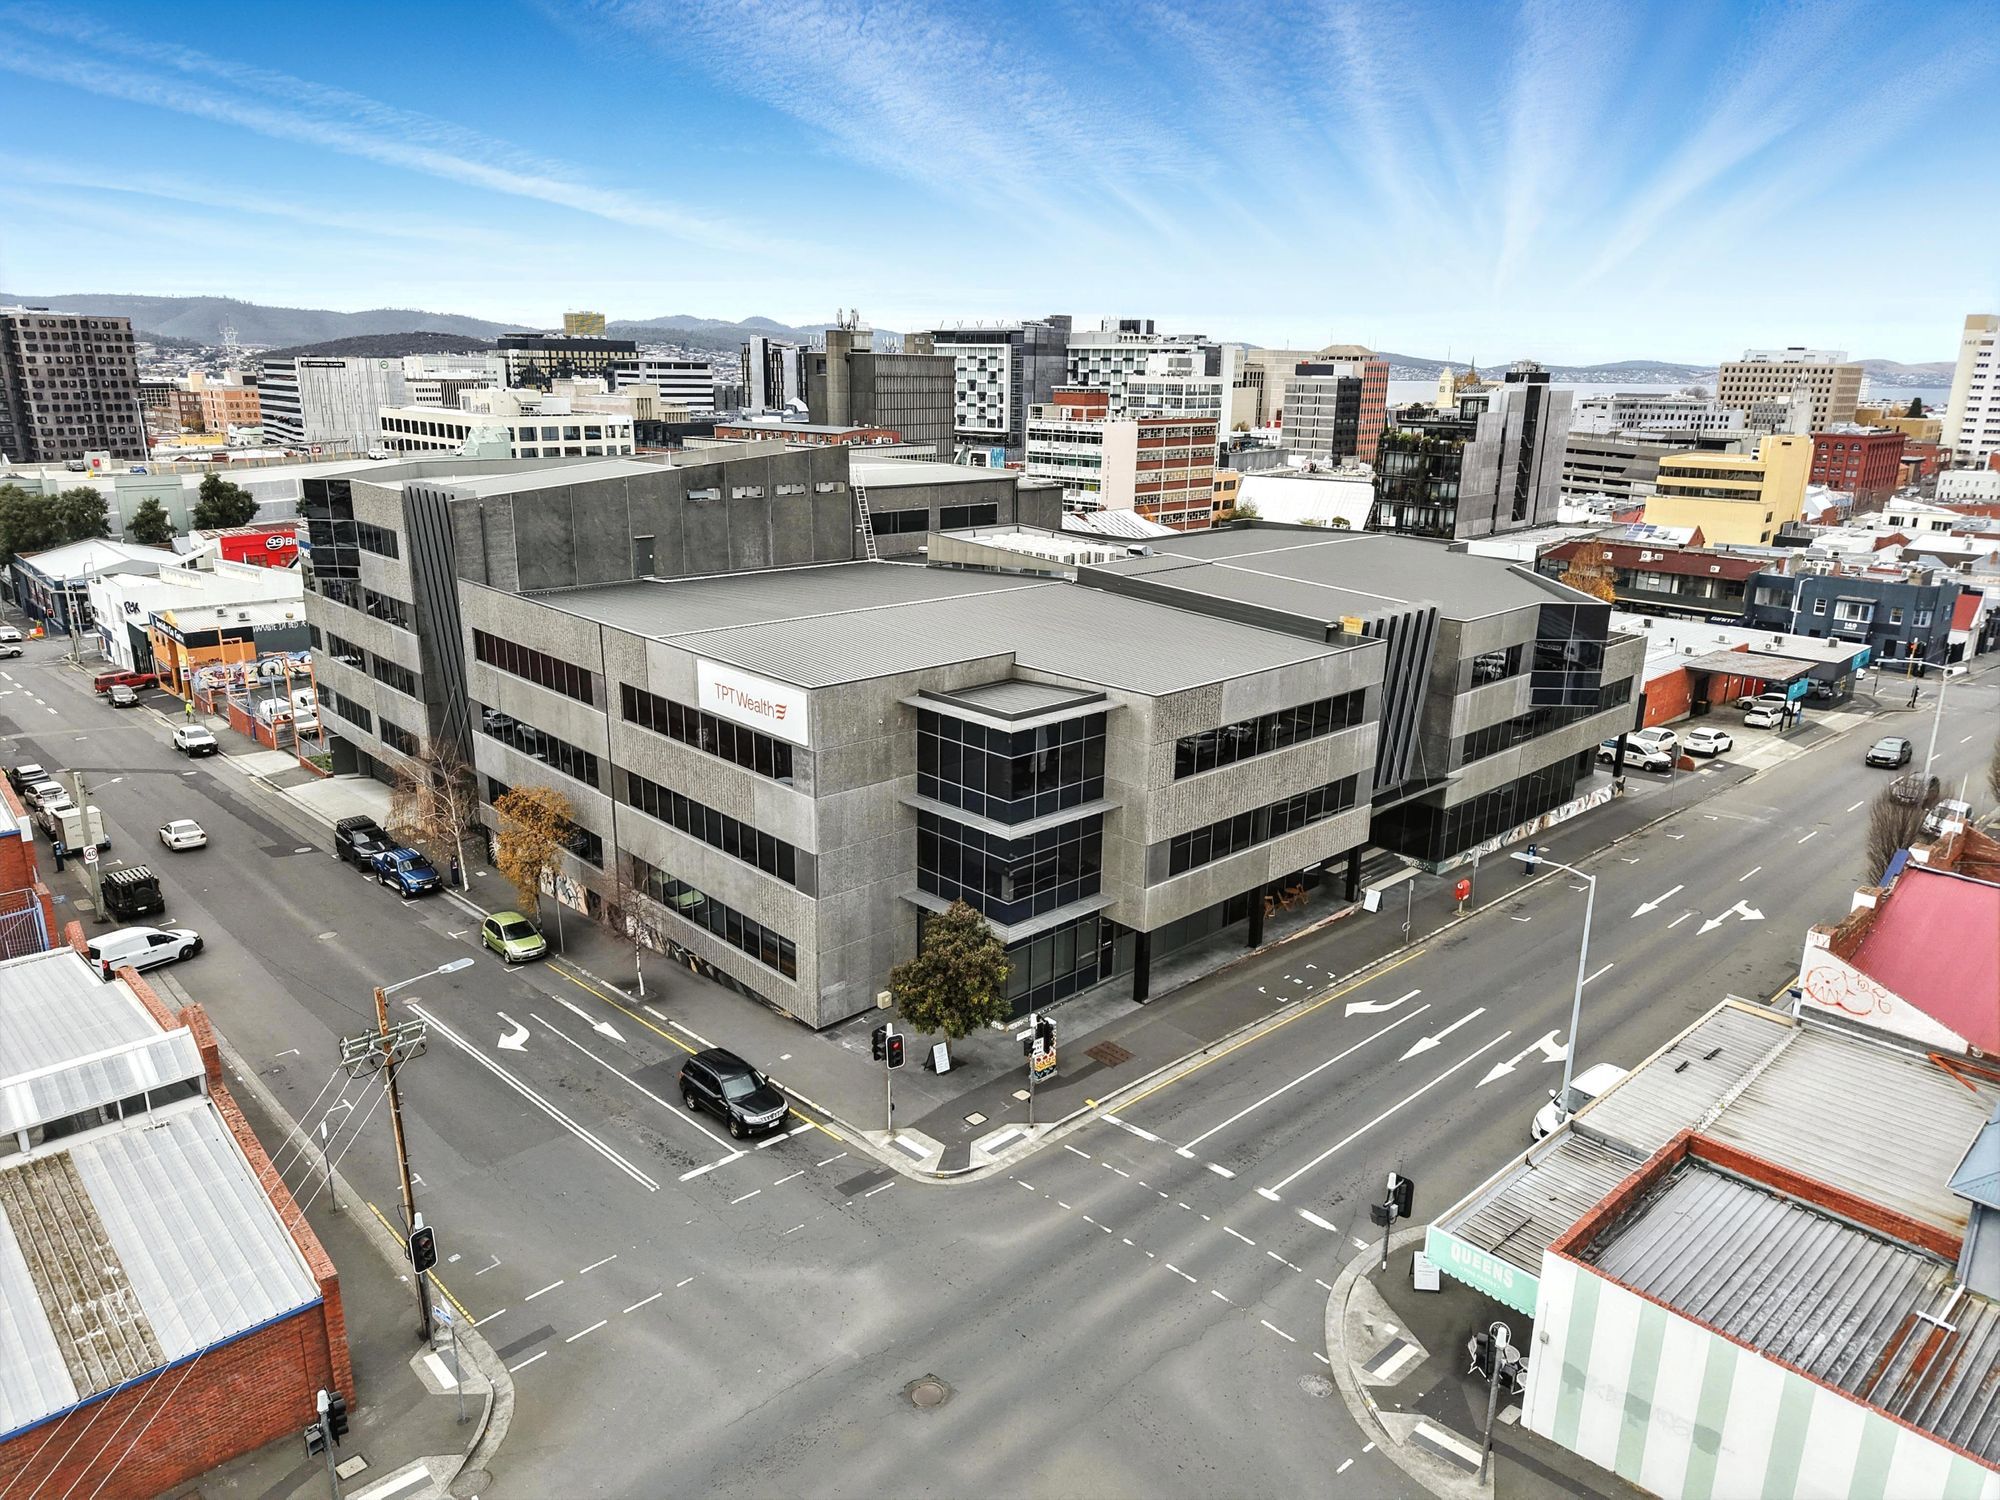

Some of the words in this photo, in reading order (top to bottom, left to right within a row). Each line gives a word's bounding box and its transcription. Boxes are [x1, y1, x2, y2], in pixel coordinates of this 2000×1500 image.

[268, 537, 283, 547] 99
[736, 690, 775, 718] Wealth
[1450, 1242, 1514, 1288] QUEENS
